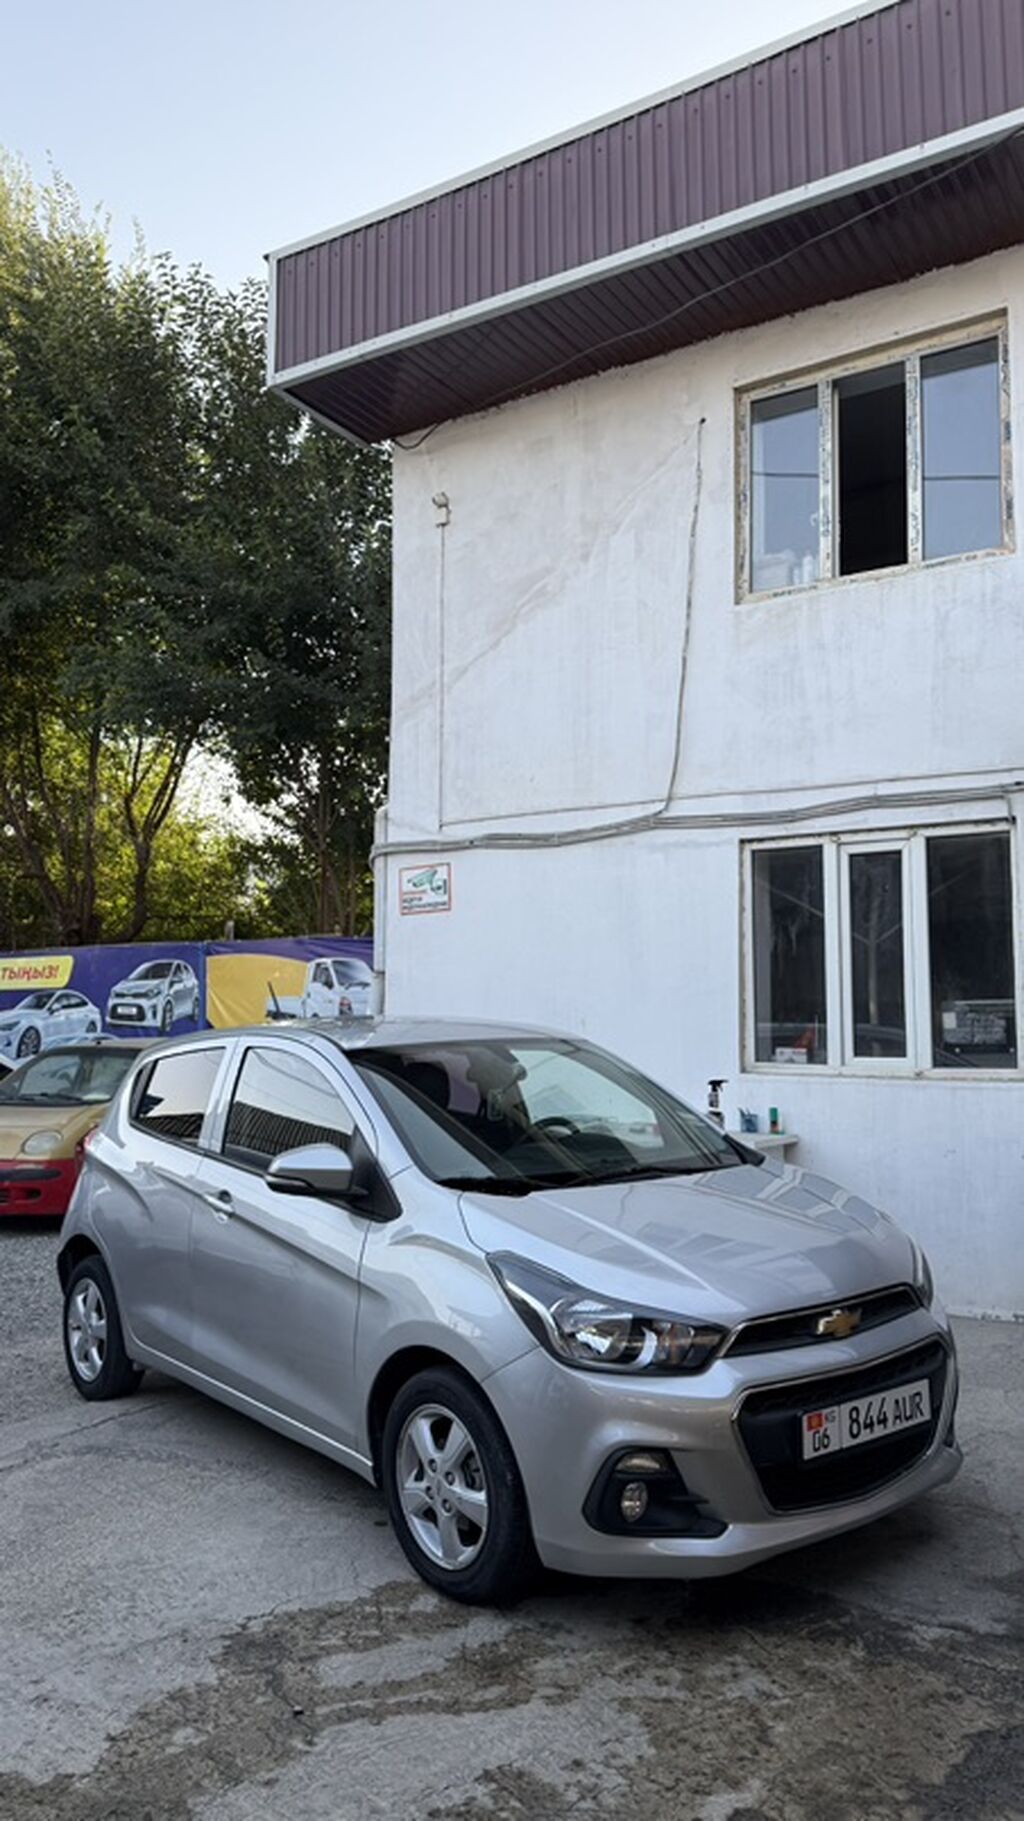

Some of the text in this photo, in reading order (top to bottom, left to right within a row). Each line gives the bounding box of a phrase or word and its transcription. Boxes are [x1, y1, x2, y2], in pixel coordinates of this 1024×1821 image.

[849, 1391, 924, 1439] 844 AUR
[812, 1428, 831, 1452] 06
